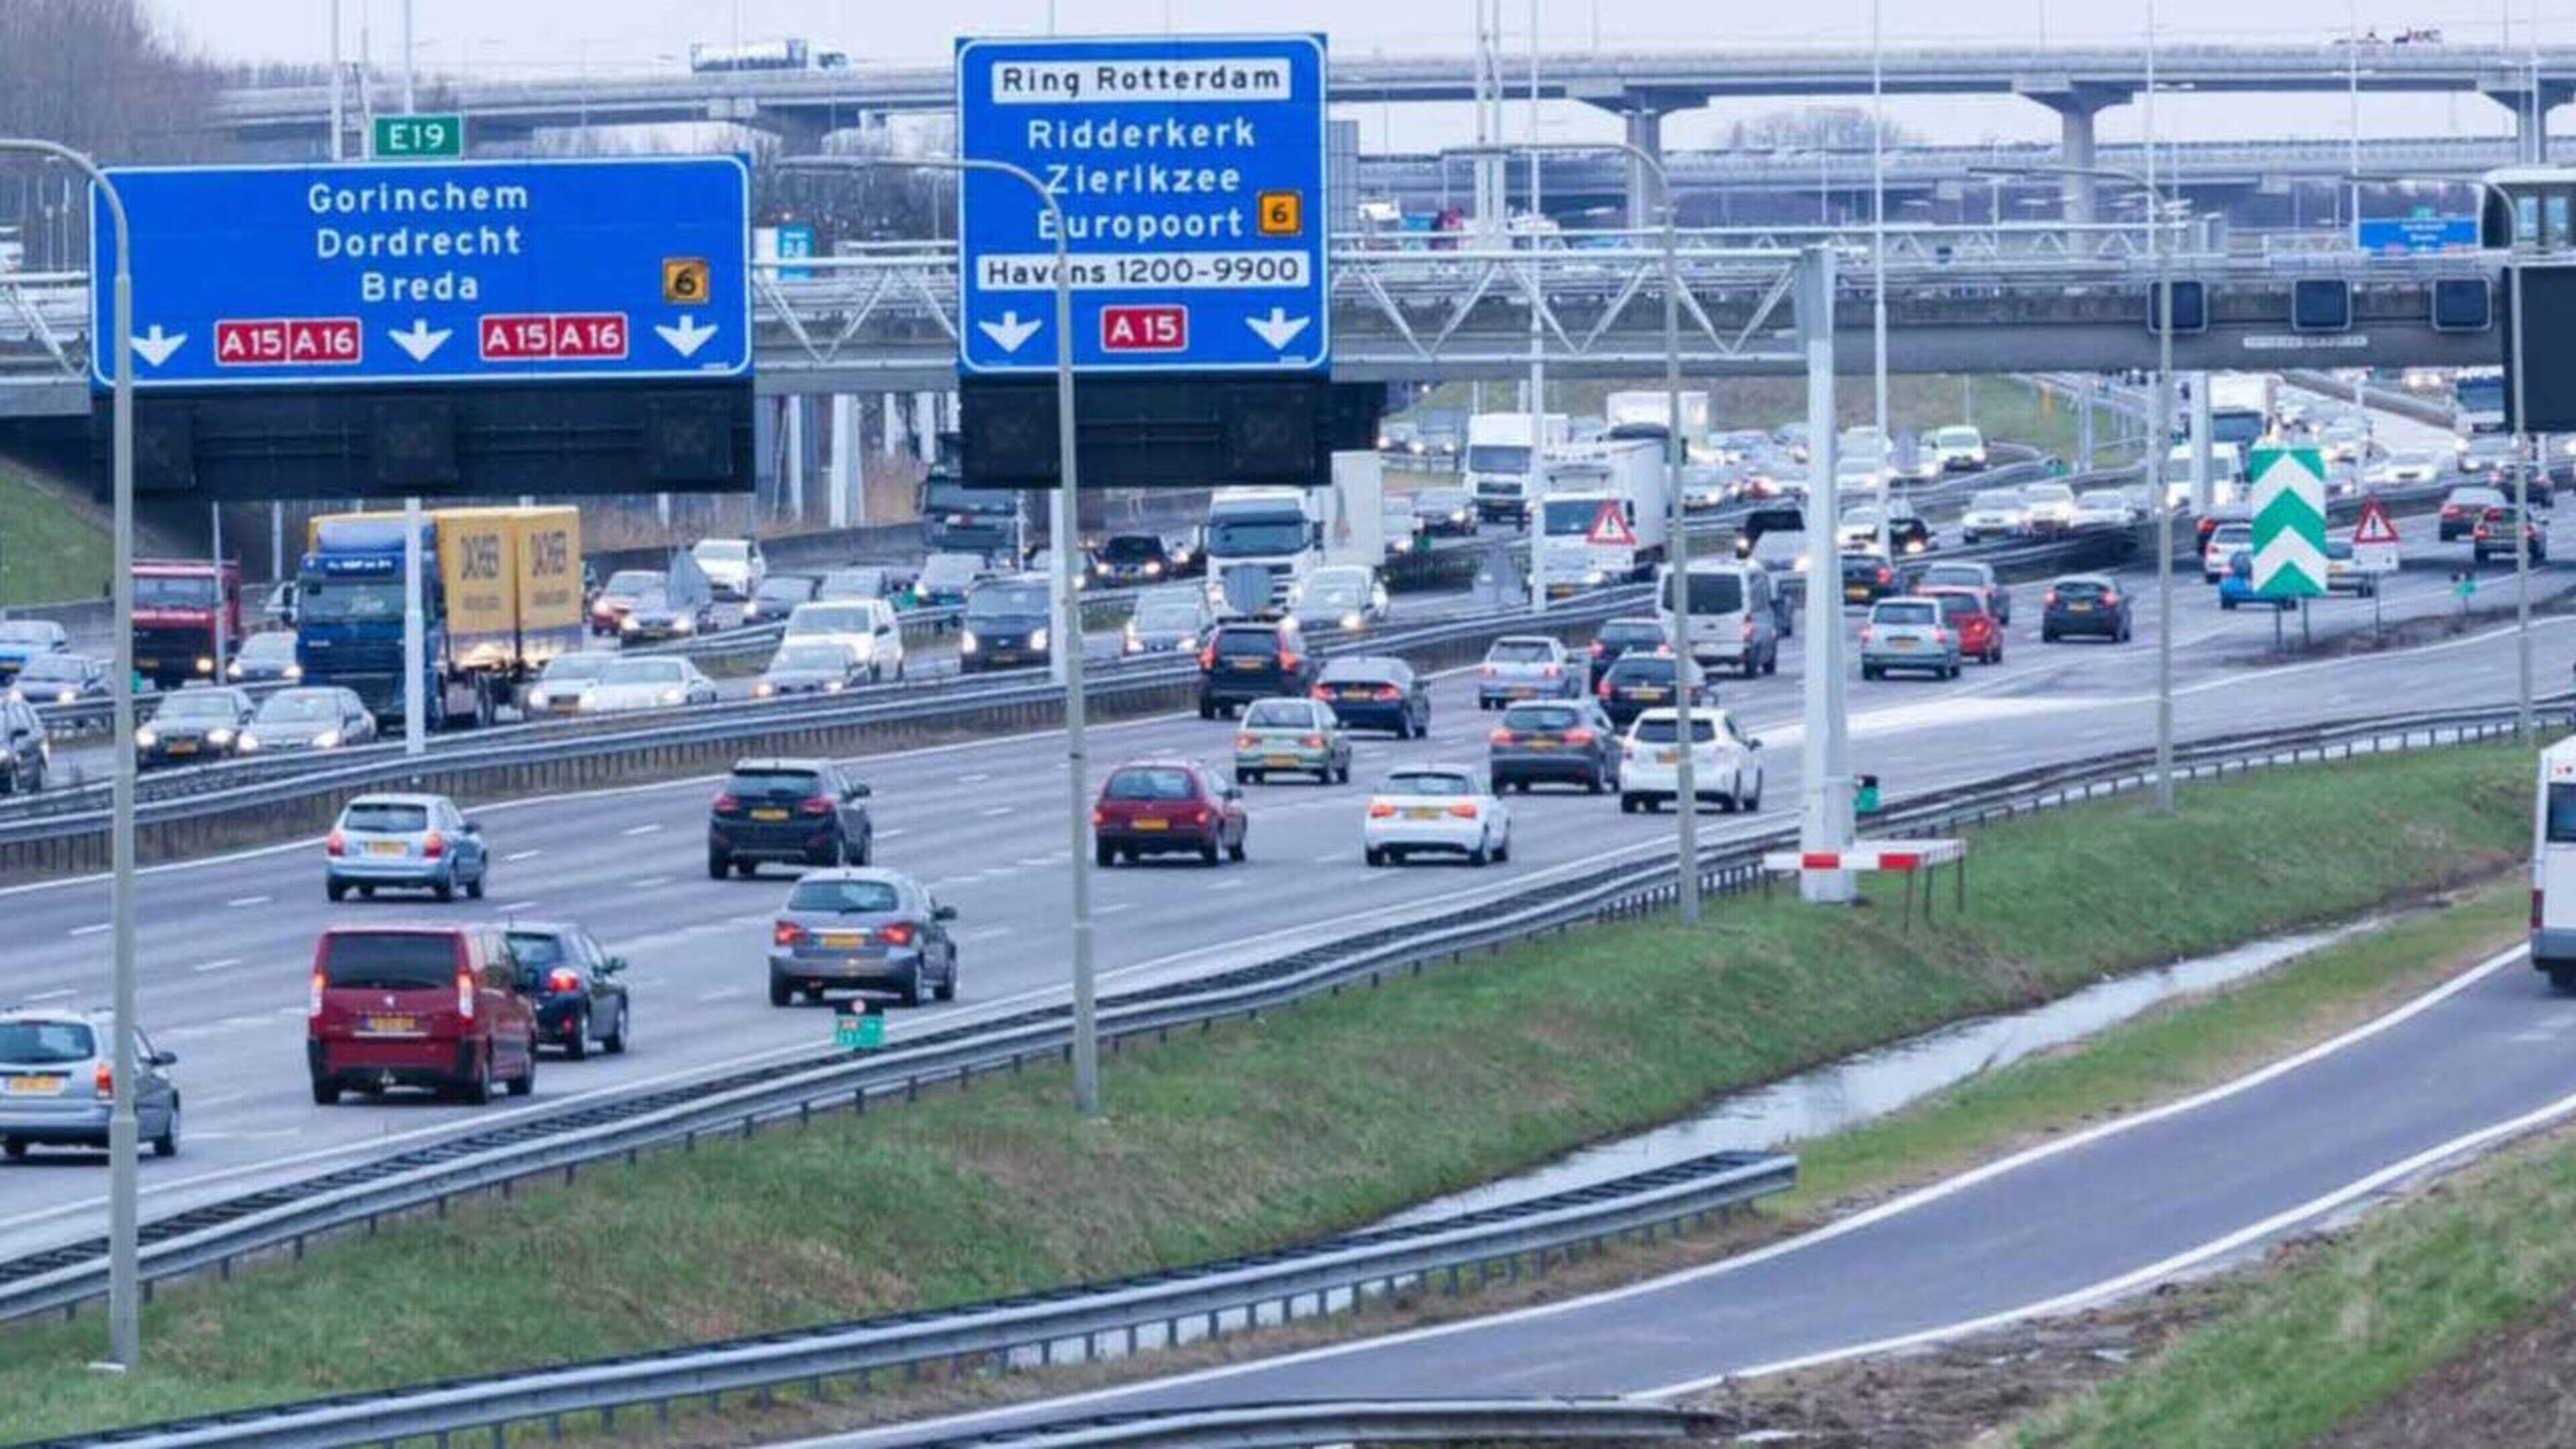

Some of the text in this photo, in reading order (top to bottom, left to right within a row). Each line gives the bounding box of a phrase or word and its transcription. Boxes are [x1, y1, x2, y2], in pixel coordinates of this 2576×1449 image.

[1002, 66, 1280, 98] Ring Rotterdam
[389, 123, 445, 150] E19
[1028, 117, 1255, 149] Ridderkerk
[1047, 164, 1240, 194] Zierikzee
[307, 181, 528, 213] Gorinchem
[1038, 208, 1242, 242] Europoort
[1271, 201, 1289, 224] 6
[317, 225, 521, 258] Dordrecht
[674, 268, 697, 296] 6
[1116, 257, 1299, 283] 1200-9900
[361, 271, 478, 301] Breda
[221, 327, 355, 356] A15 A16
[486, 323, 621, 350] A15 A16
[1110, 314, 1178, 342] A15
